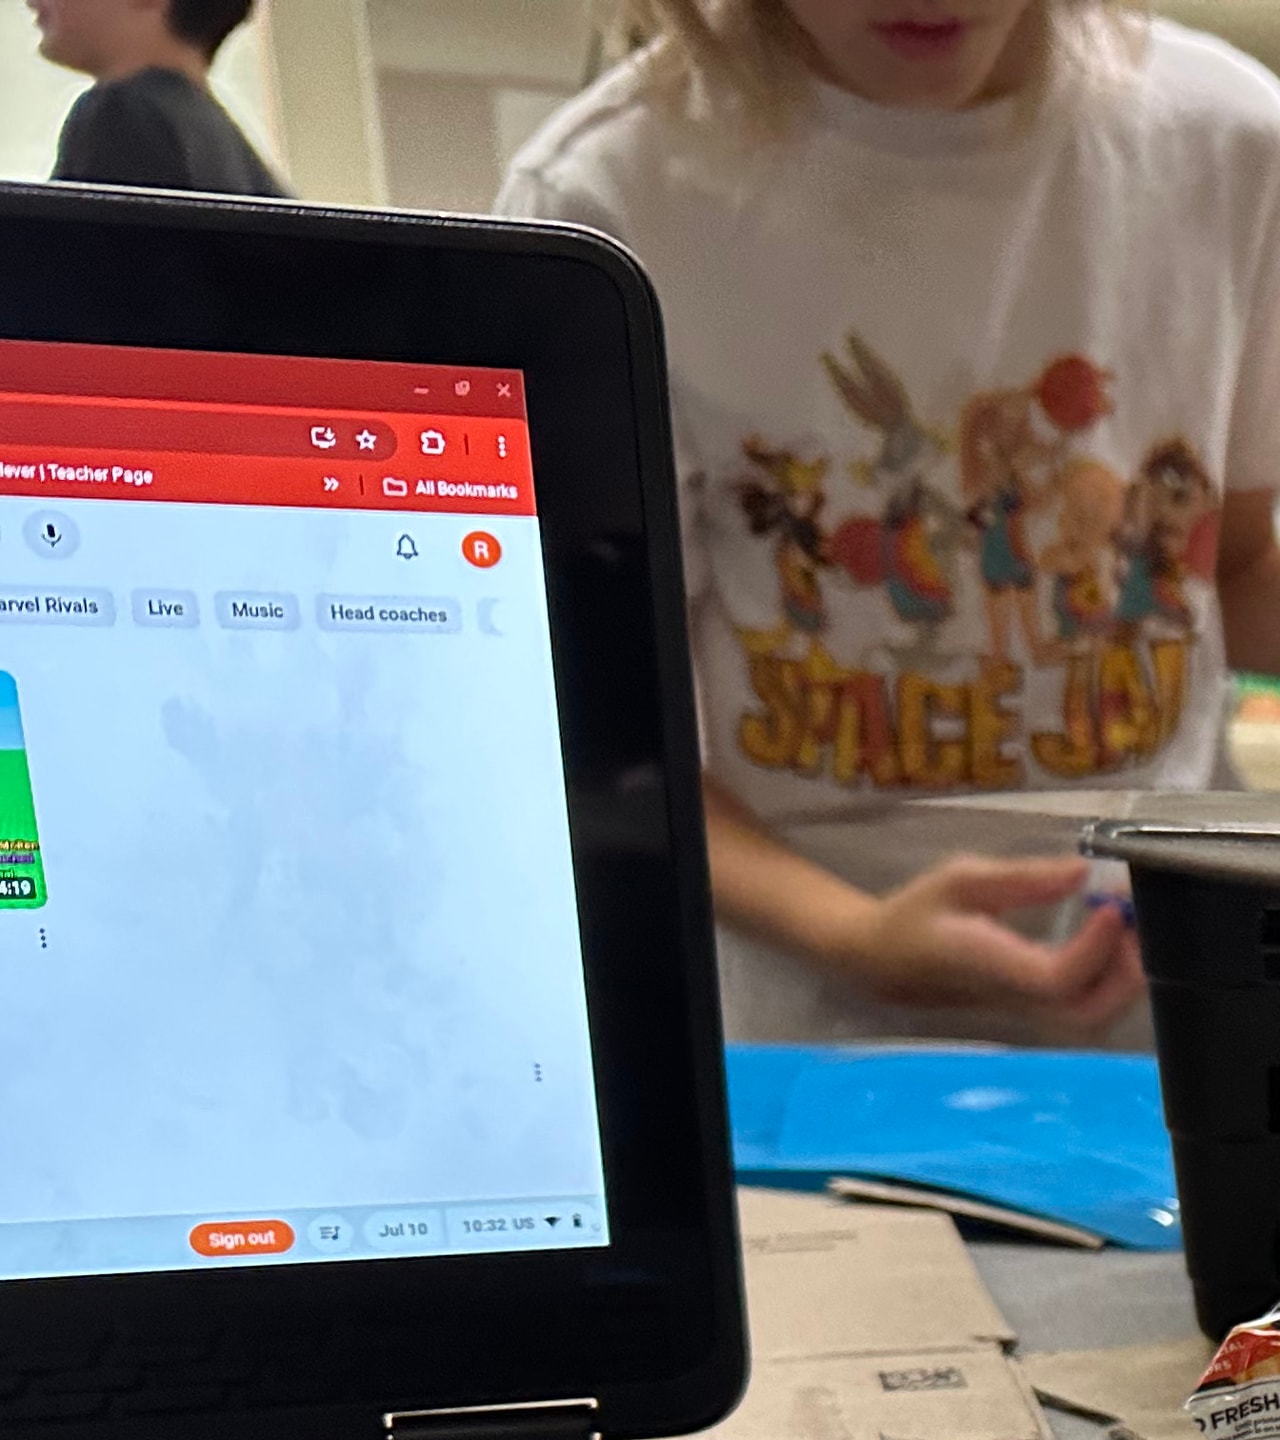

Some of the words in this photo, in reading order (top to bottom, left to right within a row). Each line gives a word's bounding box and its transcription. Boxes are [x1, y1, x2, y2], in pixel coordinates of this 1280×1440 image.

[47, 464, 108, 483] Teacher
[112, 466, 153, 486] Page
[415, 480, 435, 496] All
[437, 481, 518, 499] Bookmarks
[473, 540, 489, 559] R
[45, 596, 99, 614] Rivals
[148, 599, 184, 616] Live
[232, 601, 284, 618] Music
[330, 604, 375, 620] Head
[379, 606, 447, 622] coaches
[738, 648, 1026, 790] SPACE
[379, 1223, 405, 1237] Jul
[409, 1222, 428, 1236] 10
[463, 1219, 507, 1233] 10:32
[514, 1217, 536, 1231] US
[208, 1230, 245, 1249] Sign
[248, 1231, 276, 1246] out
[1210, 1392, 1280, 1430] FRESH
